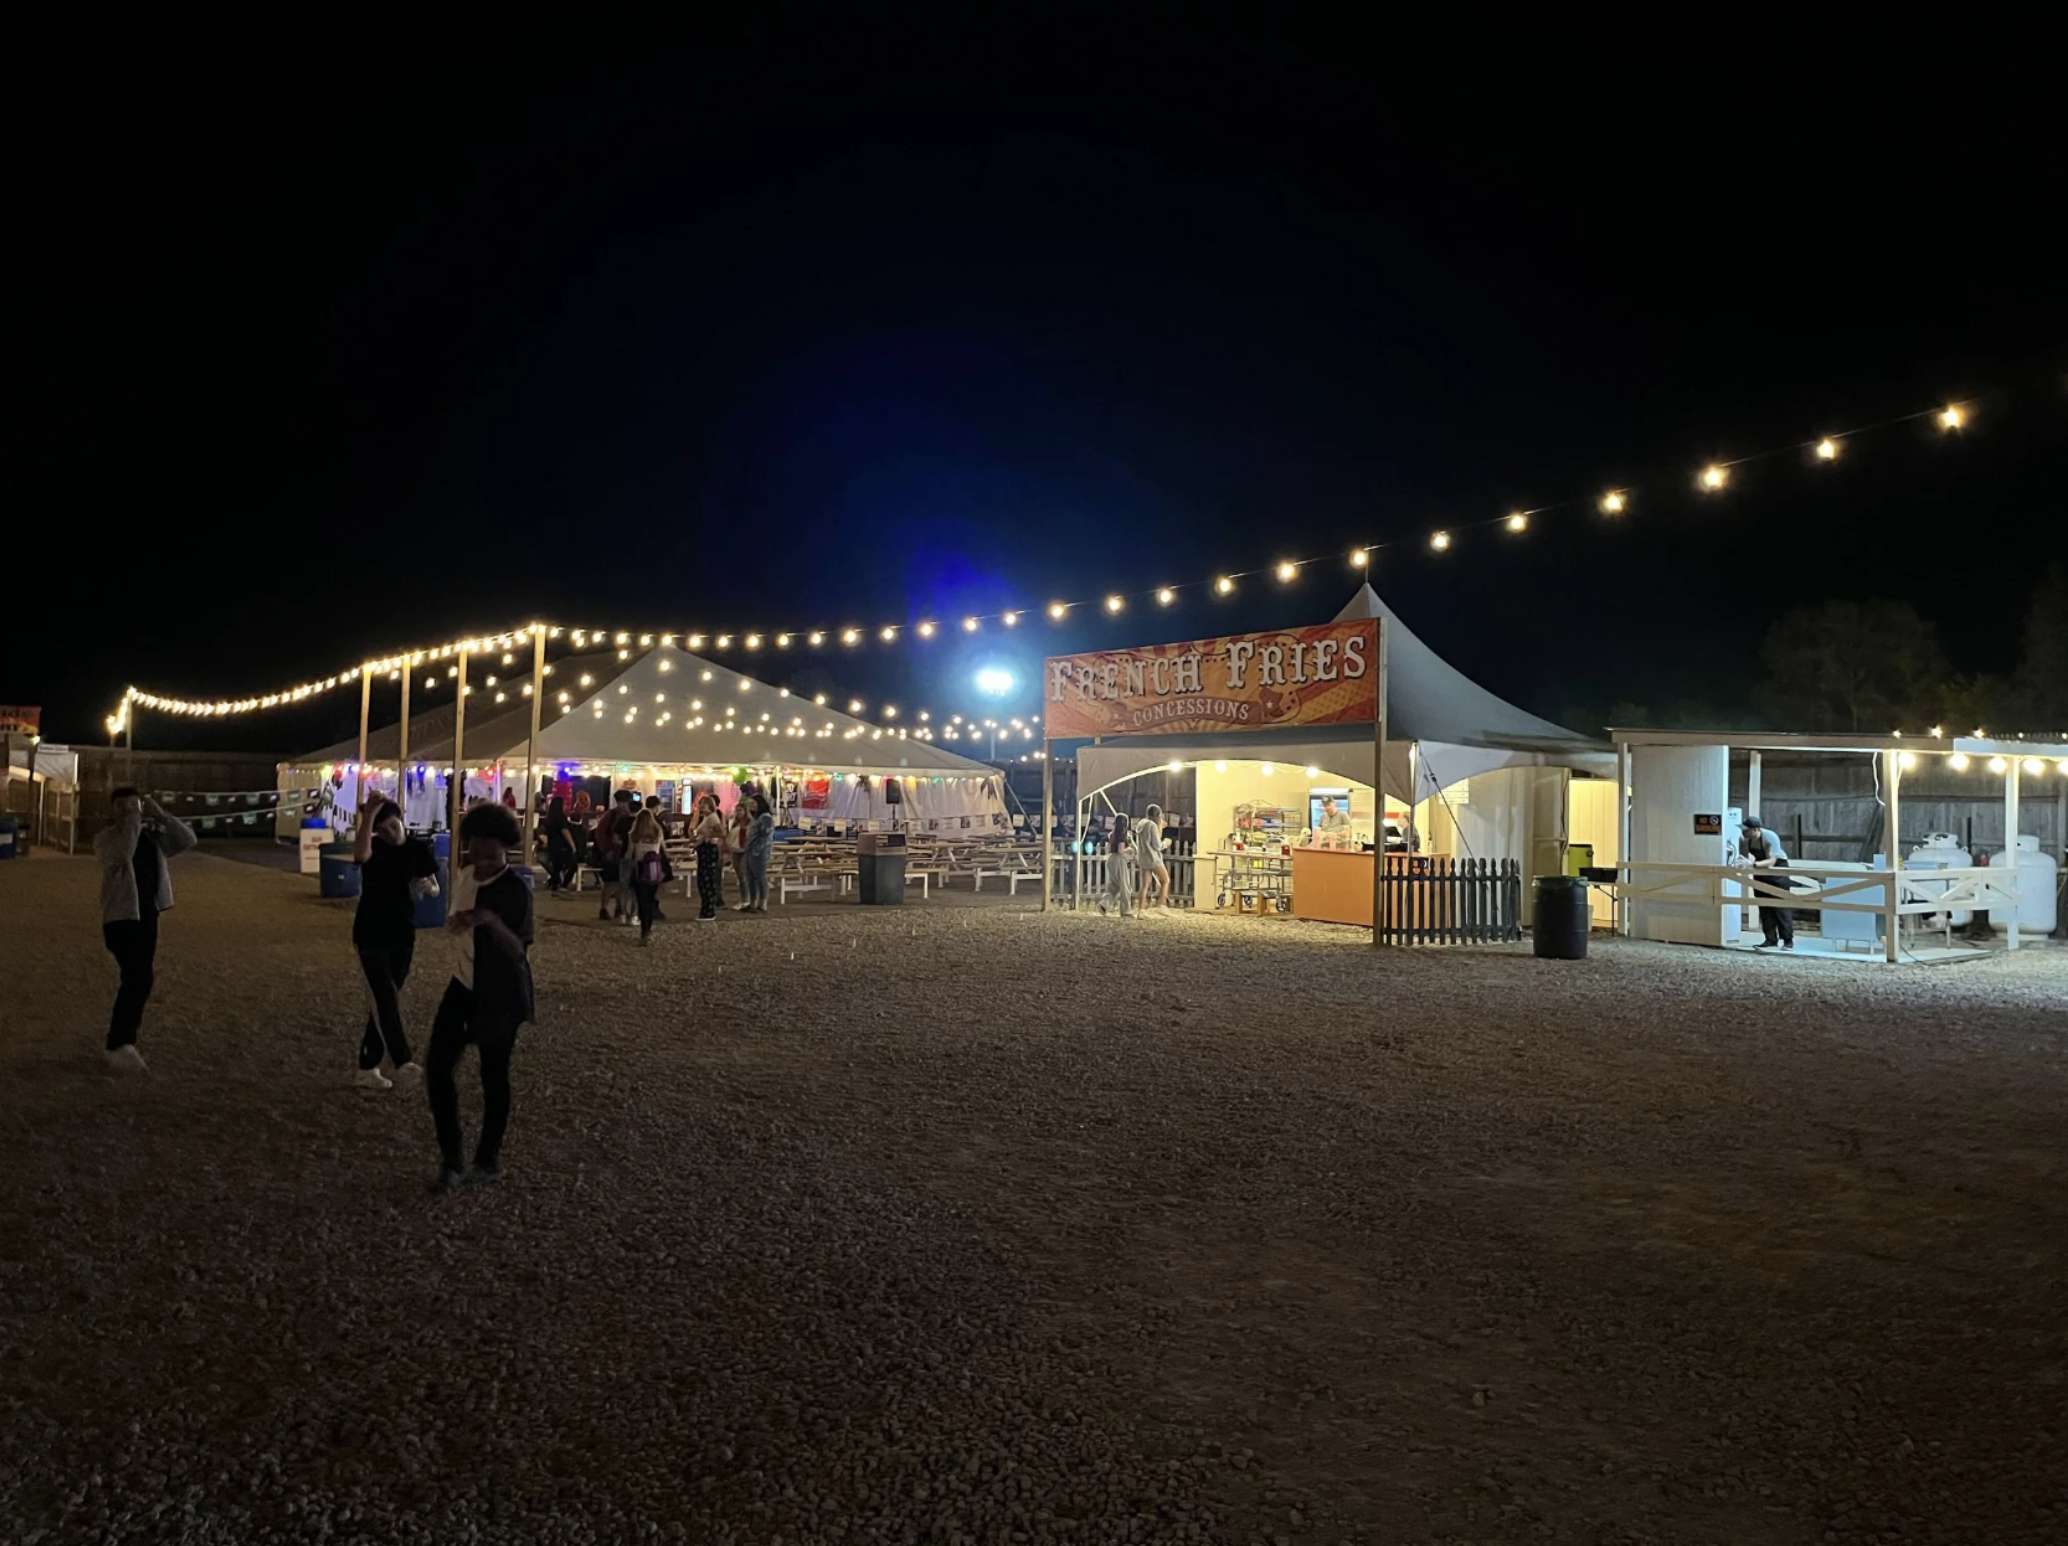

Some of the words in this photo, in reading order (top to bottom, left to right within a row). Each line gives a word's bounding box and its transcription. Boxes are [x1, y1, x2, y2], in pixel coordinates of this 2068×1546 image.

[1050, 653, 1204, 701] FRENCH
[1226, 636, 1367, 689] FRIES
[1133, 698, 1250, 726] CONCESSIONS
